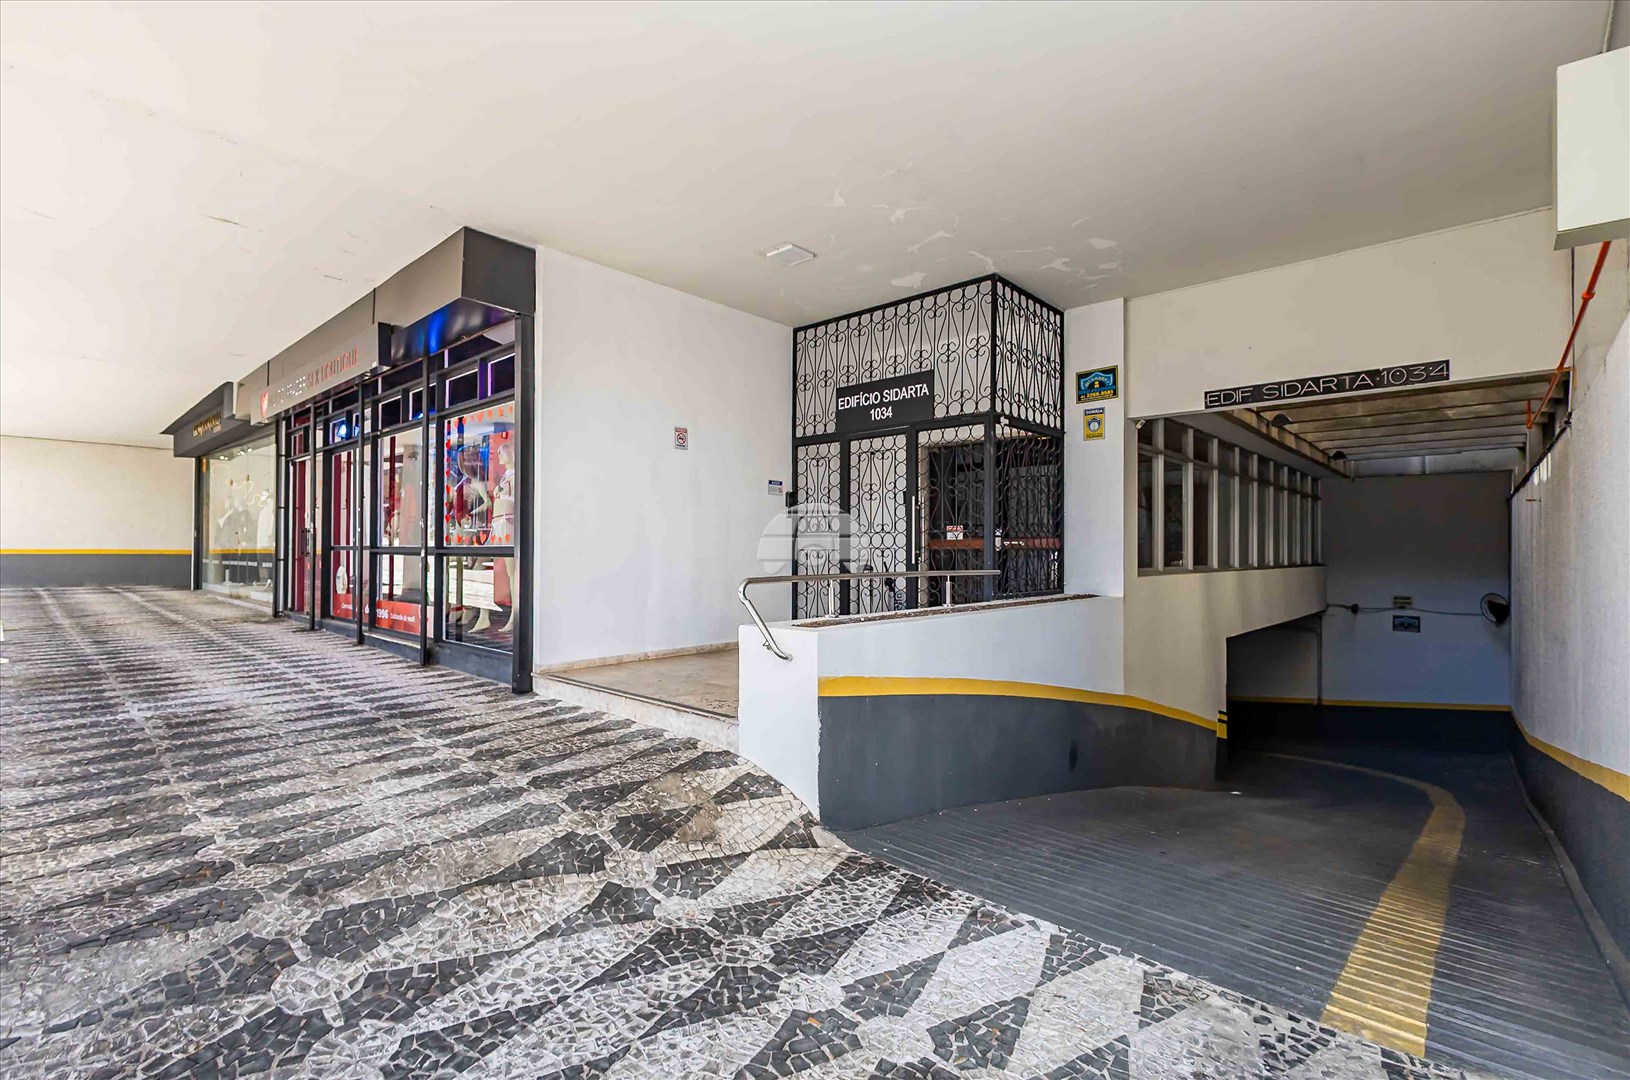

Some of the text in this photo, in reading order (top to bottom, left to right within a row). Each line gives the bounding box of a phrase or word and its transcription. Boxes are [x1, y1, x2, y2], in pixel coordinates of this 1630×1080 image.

[838, 383, 930, 411] EDIFÍCIO SIDARTA
[1206, 362, 1449, 406] EDIF SIDARTA 1034
[869, 406, 893, 421] 1034
